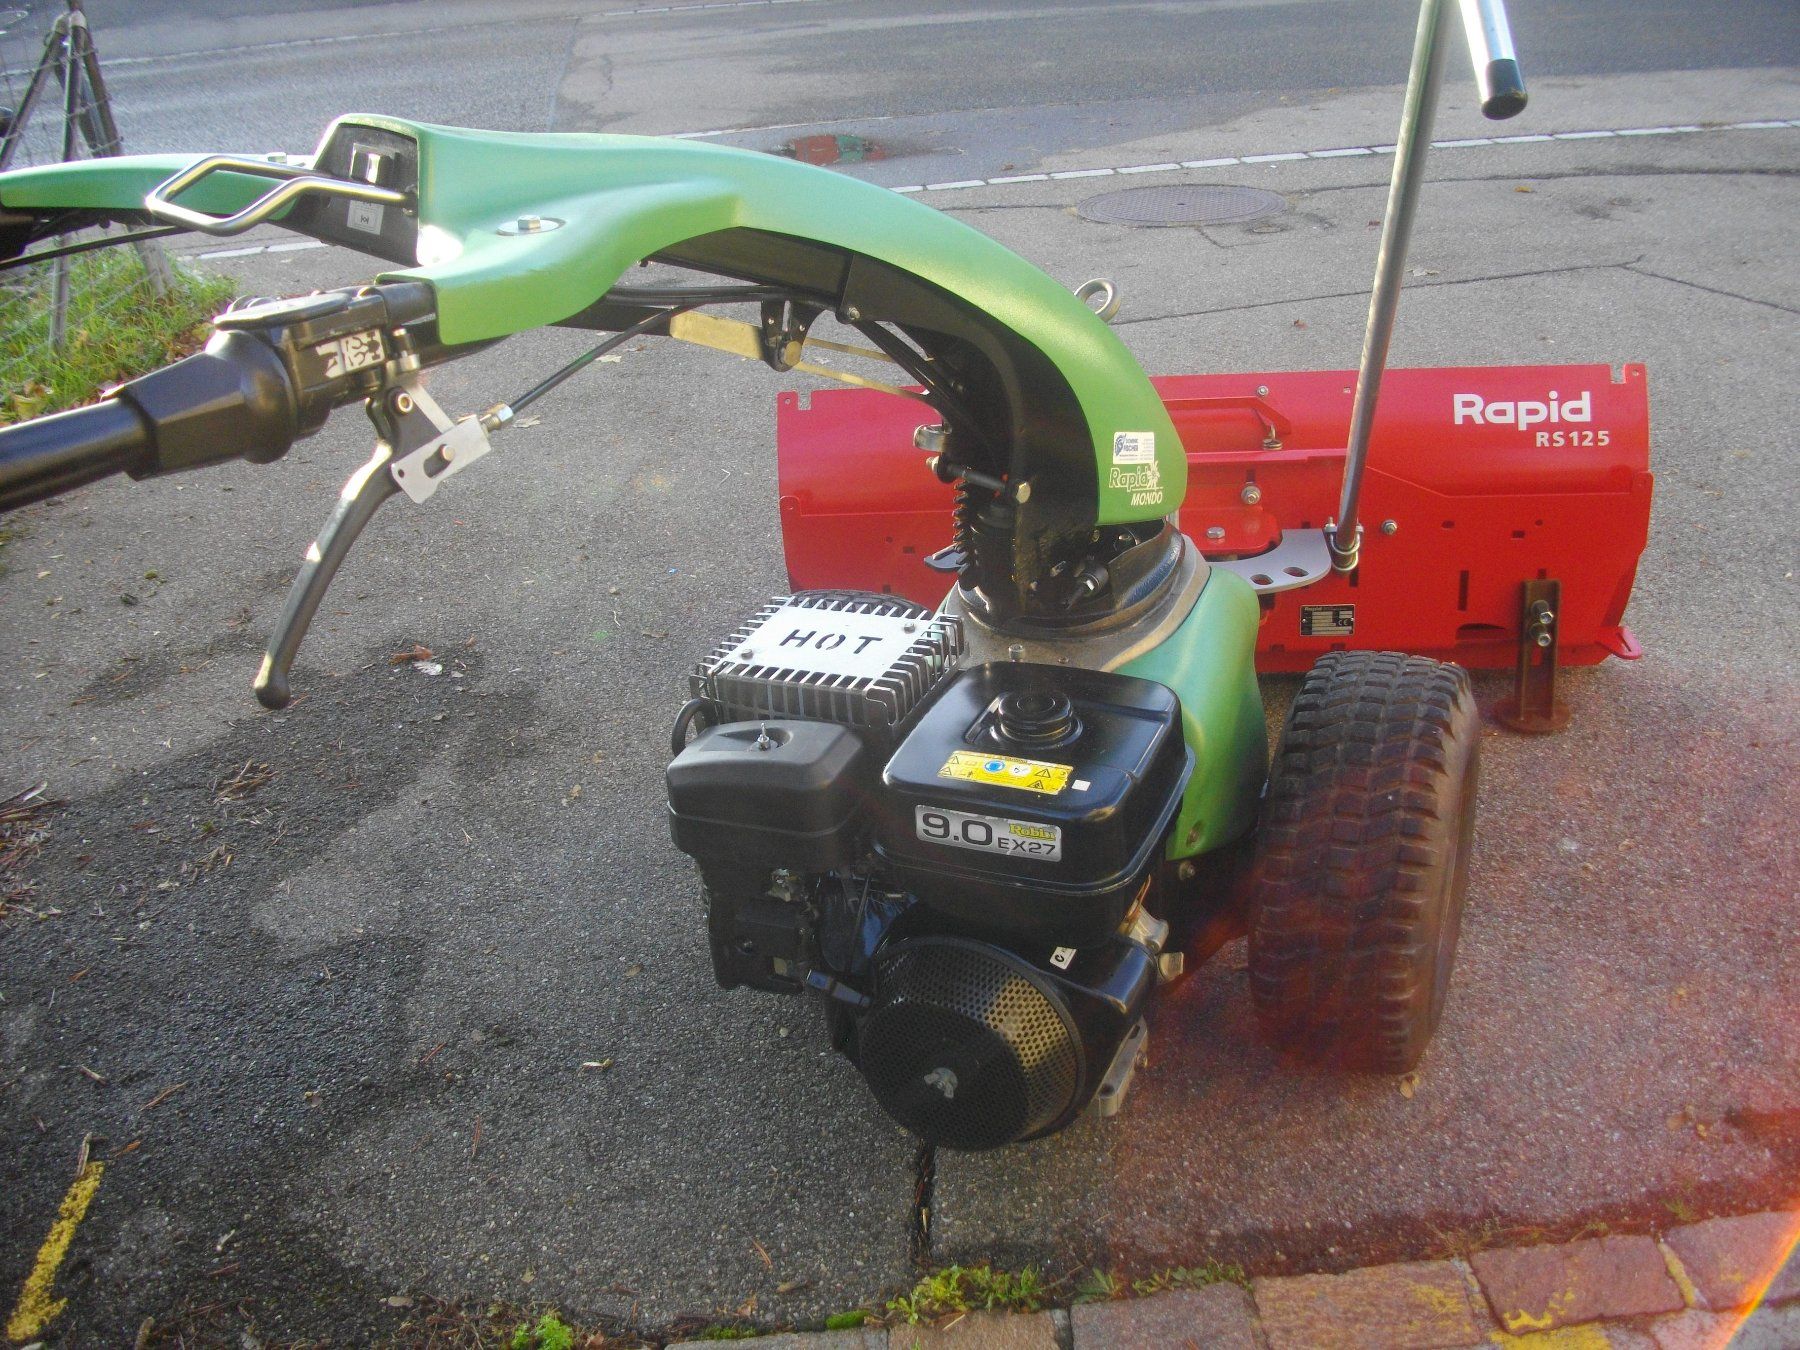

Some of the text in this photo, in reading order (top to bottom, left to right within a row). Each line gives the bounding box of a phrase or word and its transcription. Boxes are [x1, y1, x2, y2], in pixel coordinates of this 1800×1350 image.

[1453, 390, 1592, 431] Rapid
[1109, 466, 1149, 492] Rapid
[1131, 491, 1163, 506] MONDO
[779, 629, 883, 654] HOT
[922, 812, 993, 846] 9.0
[1009, 823, 1056, 842] Robin
[997, 837, 1056, 855] EX27
